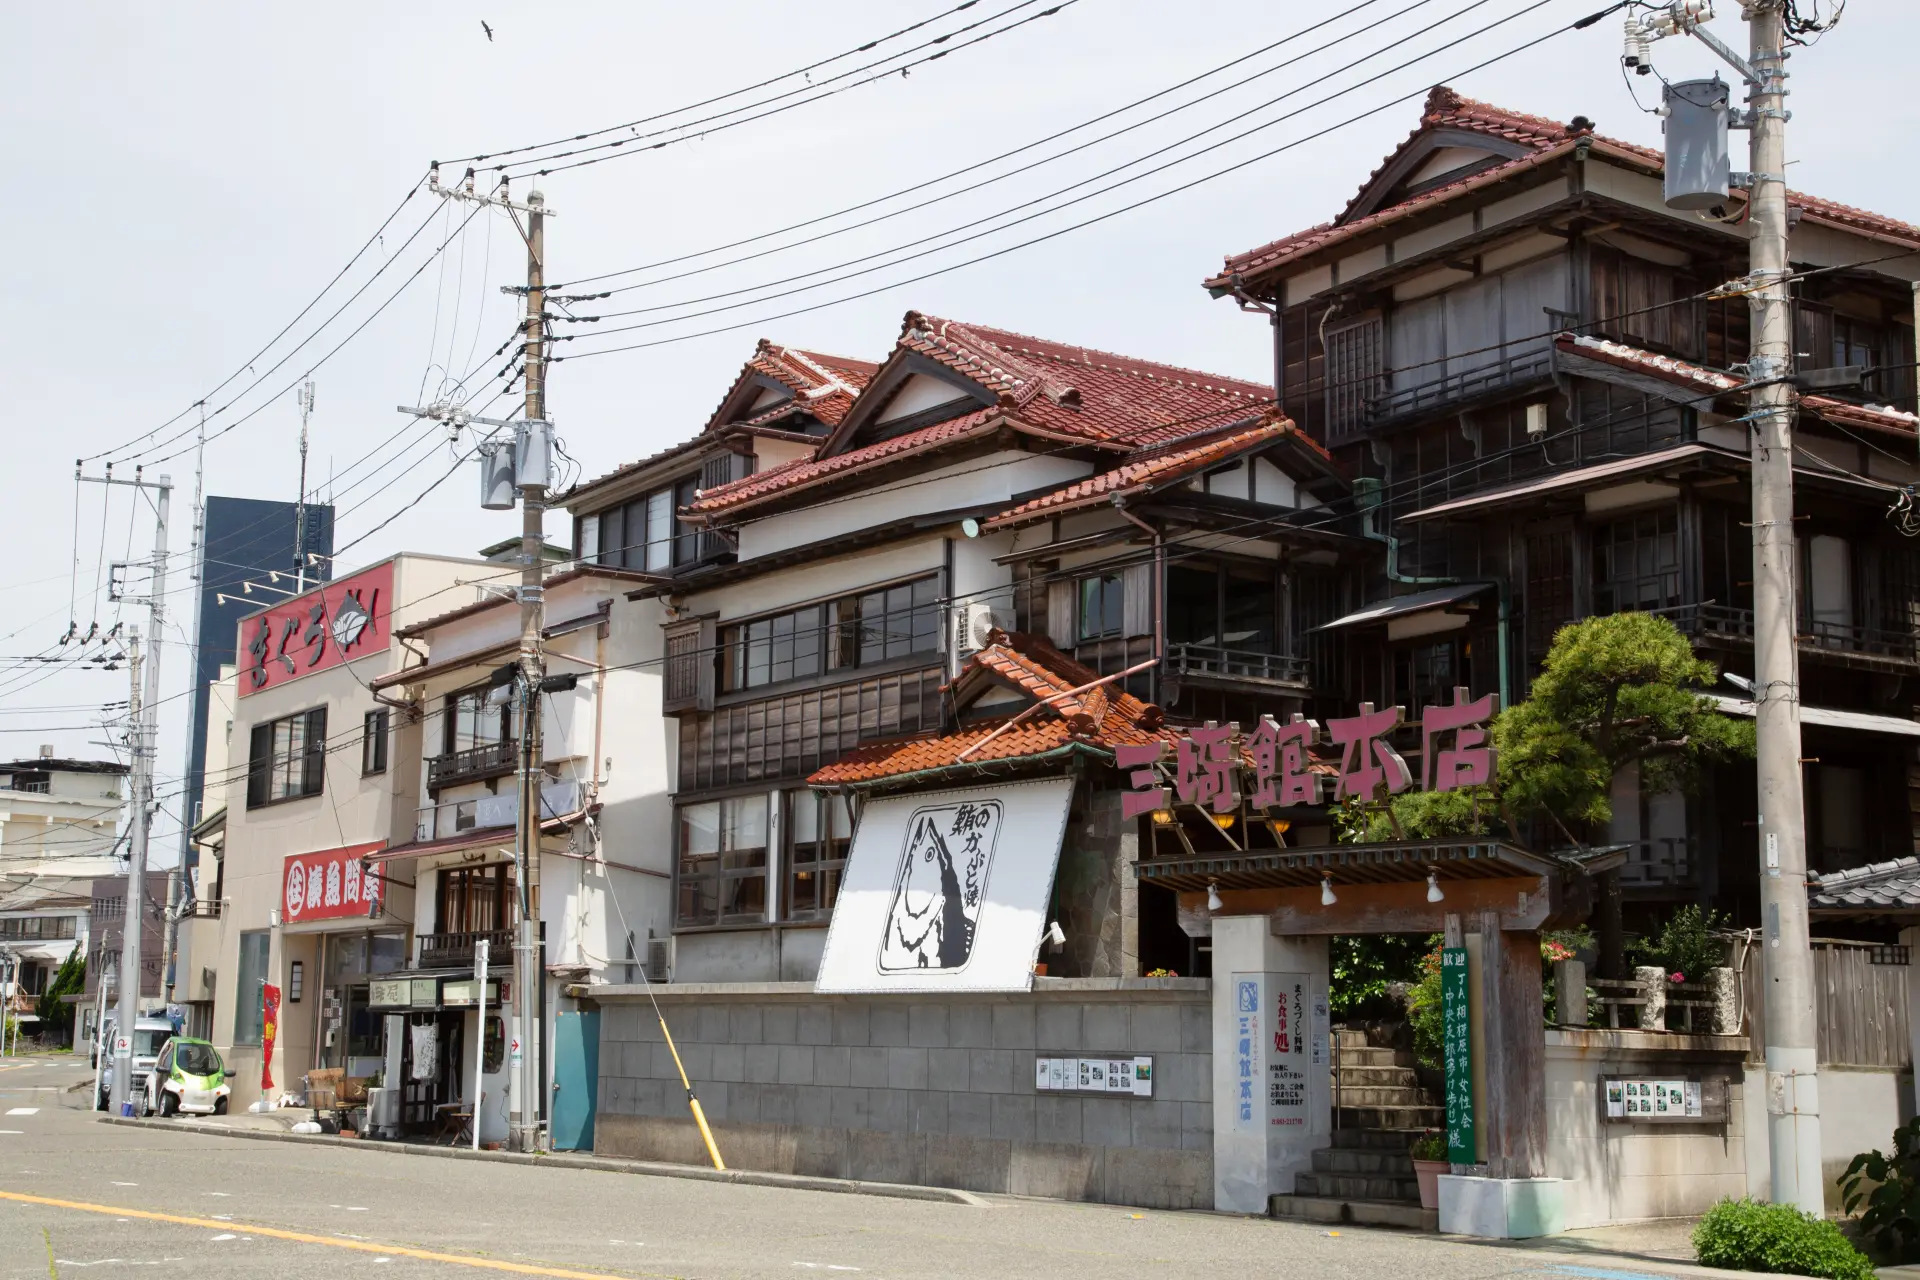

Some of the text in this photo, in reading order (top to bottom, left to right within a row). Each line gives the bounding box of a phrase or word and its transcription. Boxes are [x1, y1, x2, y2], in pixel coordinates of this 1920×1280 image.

[249, 602, 325, 688] まぐろ
[1115, 686, 1500, 821] 三崎館本店
[949, 804, 990, 908] 鮪のかぶと焼
[1444, 952, 1465, 966] 歓迎
[1274, 992, 1290, 1053] お食事処
[1294, 984, 1303, 1054] まぐろづくし料理
[1457, 973, 1472, 1128] JA相模原市女性会
